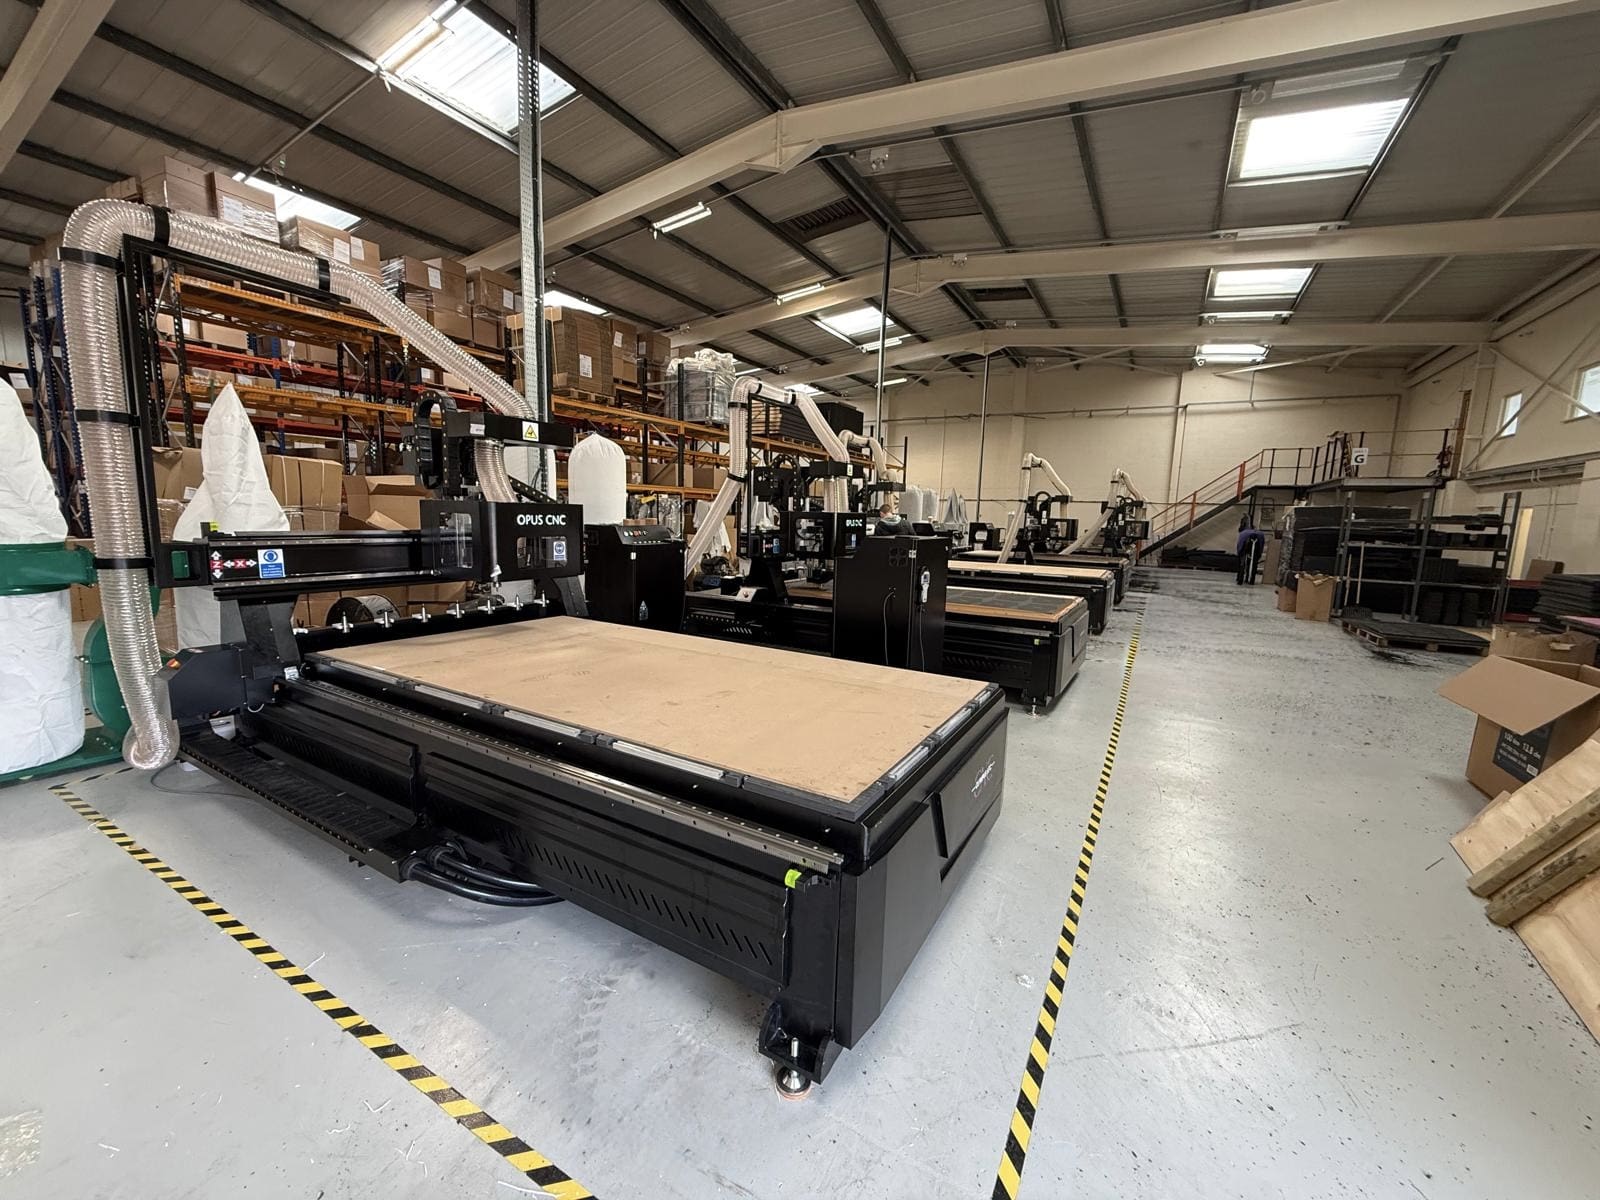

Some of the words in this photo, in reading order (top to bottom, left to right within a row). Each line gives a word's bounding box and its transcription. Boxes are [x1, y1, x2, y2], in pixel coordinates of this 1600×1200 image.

[1354, 454, 1364, 463] G
[516, 514, 543, 526] OPUS
[545, 514, 567, 526] CNC
[213, 561, 221, 569] Z
[235, 560, 245, 568] X
